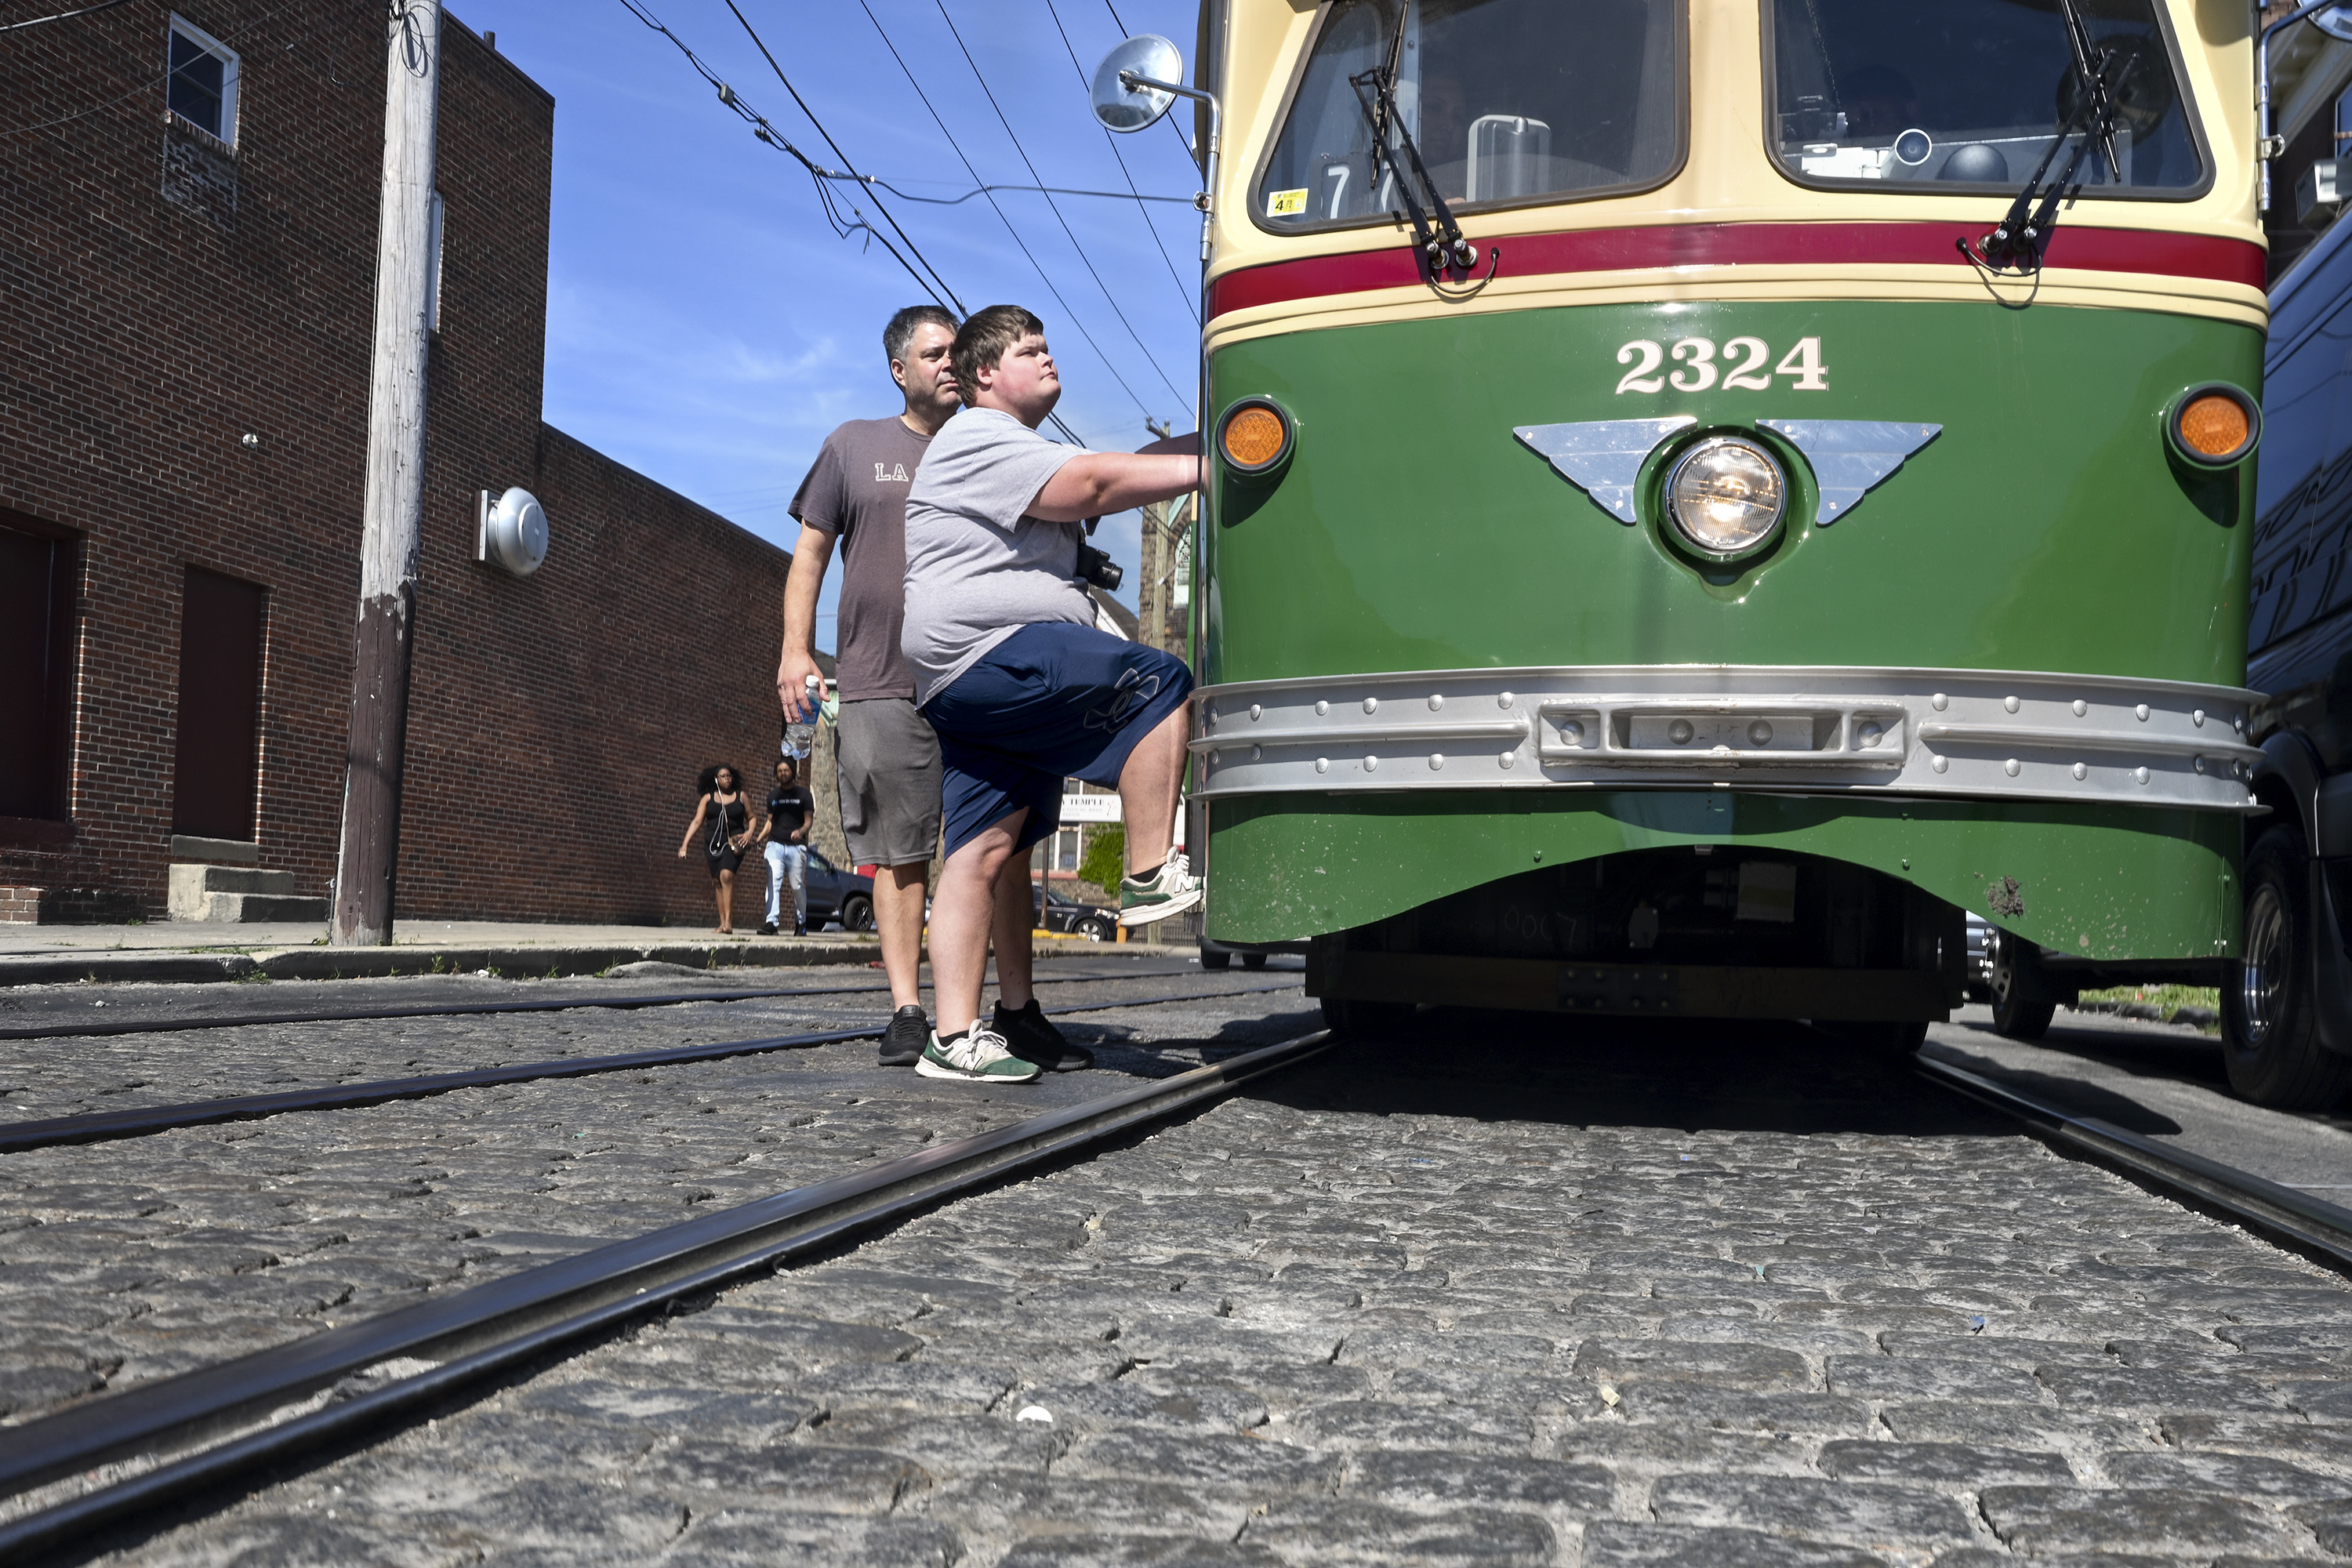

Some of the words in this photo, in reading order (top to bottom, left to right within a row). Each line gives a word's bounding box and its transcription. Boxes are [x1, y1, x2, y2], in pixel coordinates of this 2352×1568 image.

[1328, 166, 1350, 220] 7
[1615, 336, 1829, 395] 2324
[1174, 872, 1196, 894] N
